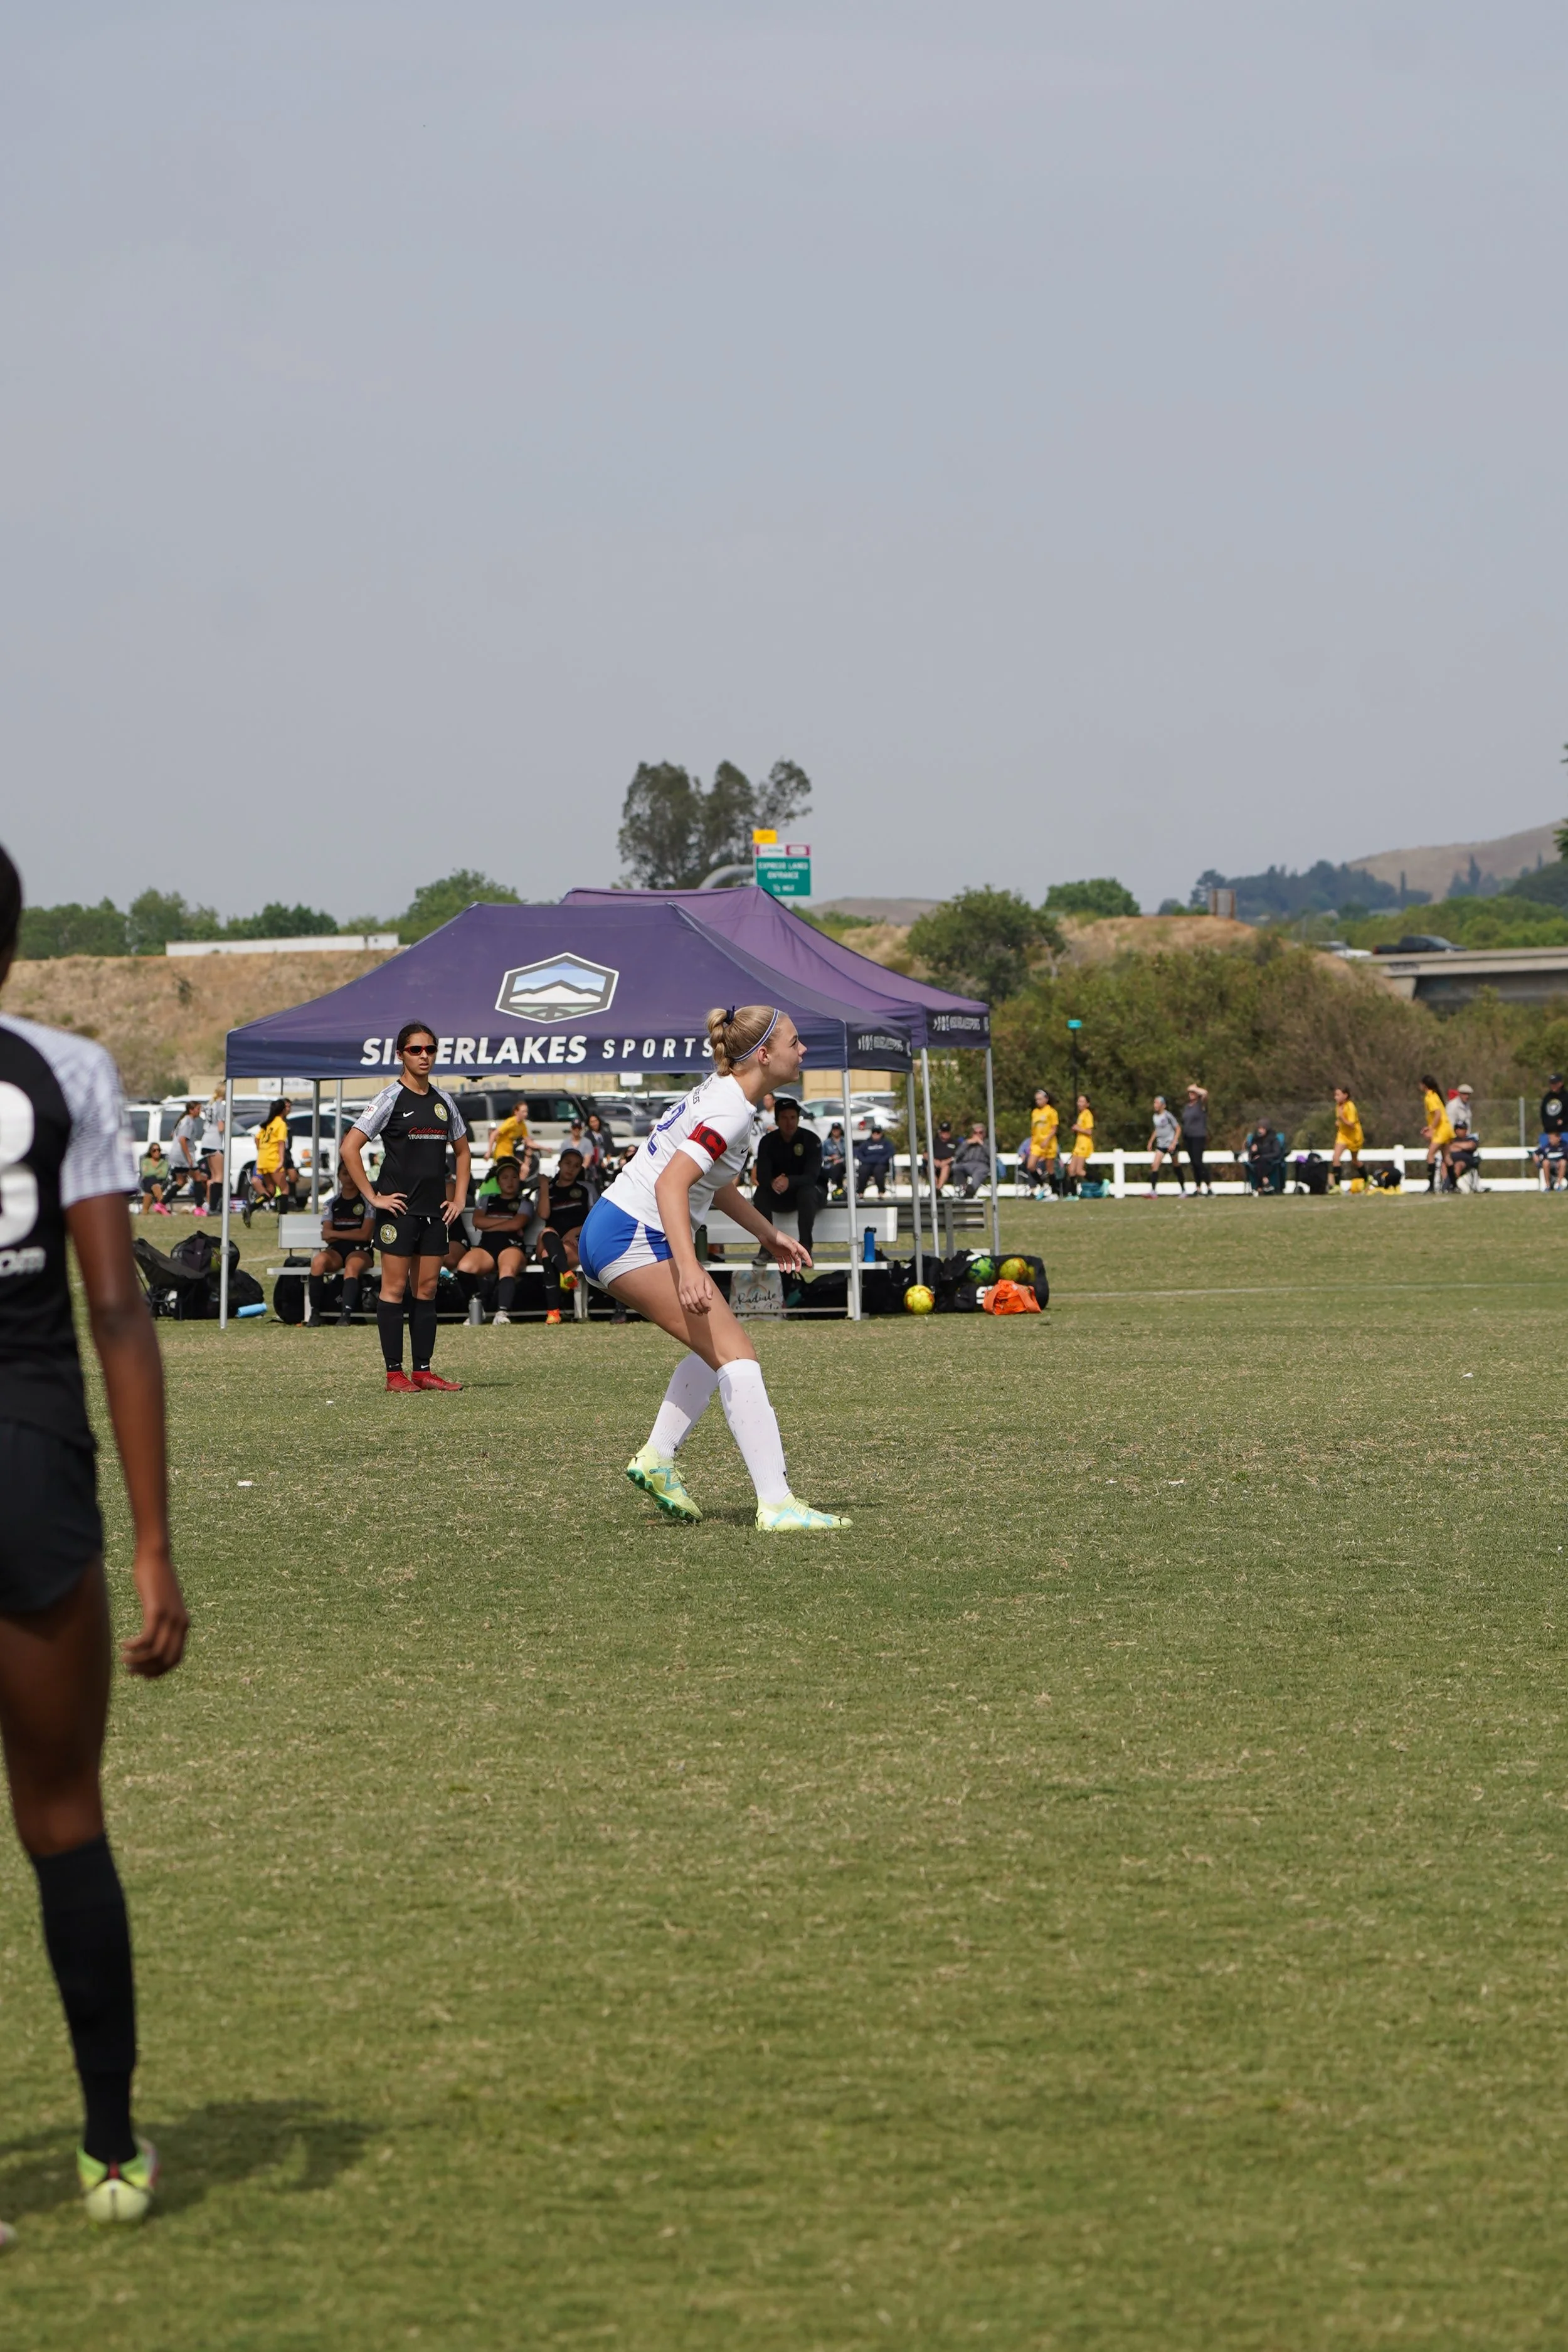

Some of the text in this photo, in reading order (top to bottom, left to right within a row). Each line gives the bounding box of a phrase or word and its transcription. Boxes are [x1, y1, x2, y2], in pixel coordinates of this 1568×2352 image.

[360, 1036, 714, 1065] SIERLAKES SPORTS
[701, 1129, 722, 1154] C
